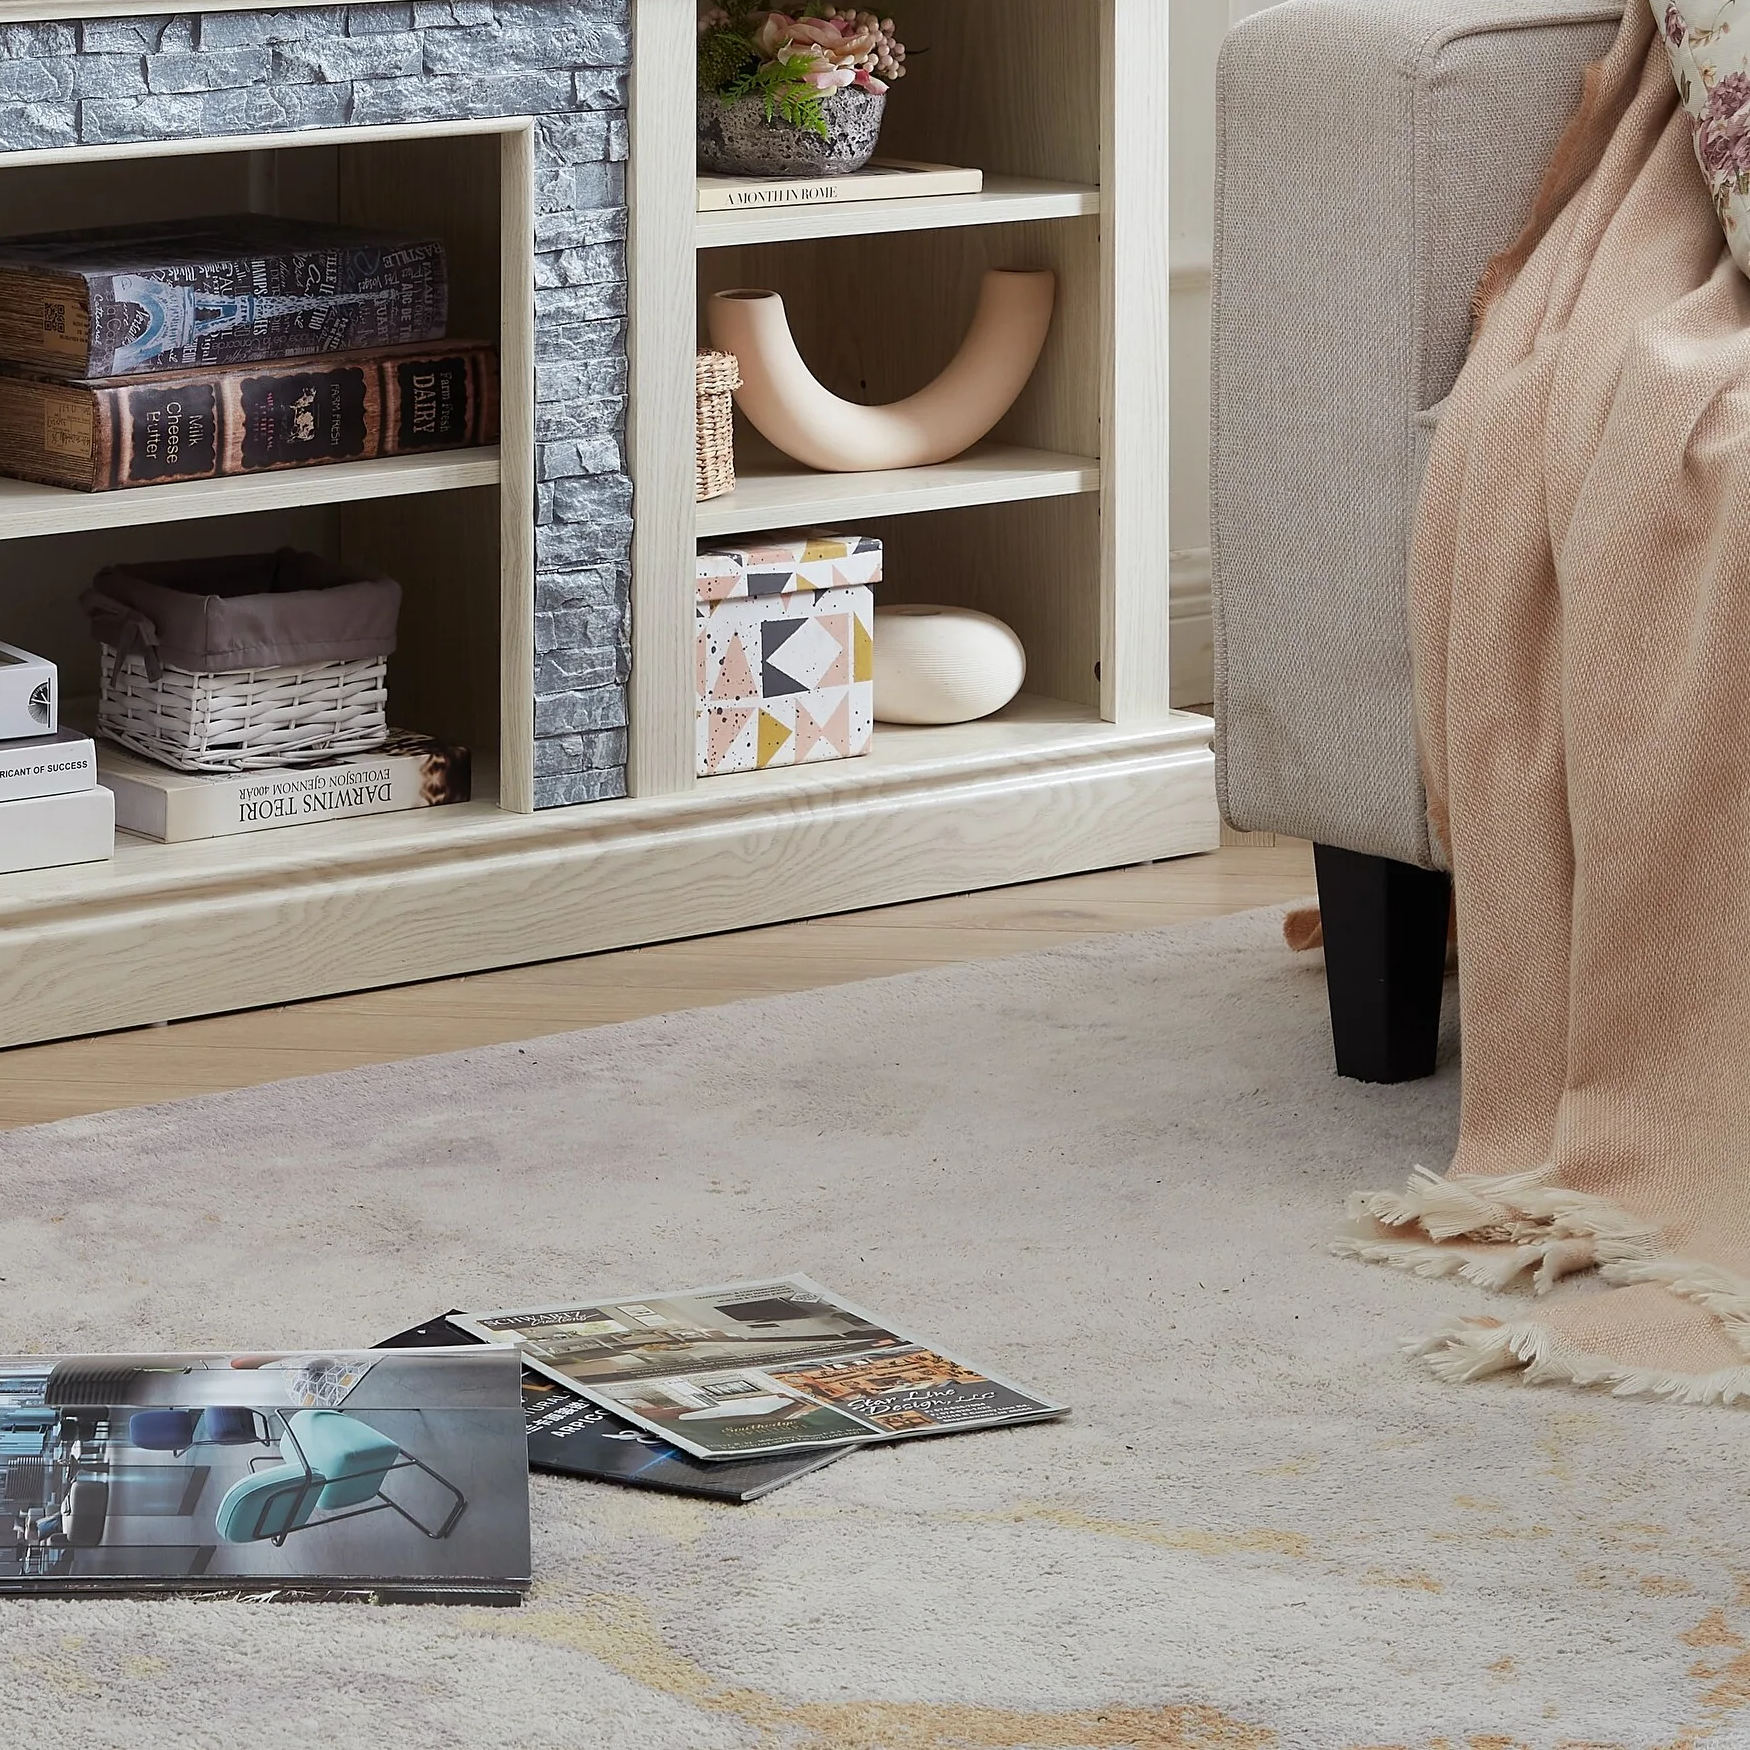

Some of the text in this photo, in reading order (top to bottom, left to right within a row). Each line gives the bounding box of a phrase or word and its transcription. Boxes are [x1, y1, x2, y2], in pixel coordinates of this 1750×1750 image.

[725, 186, 838, 205] A MONTH IN ROME
[412, 374, 436, 435] DAIRY
[440, 372, 454, 433] Farm Fresh
[146, 411, 161, 460] Butter
[166, 401, 182, 464] Cheese
[188, 414, 204, 446] Milk
[33, 765, 45, 776] OF
[47, 760, 88, 774] SUCCESS
[329, 768, 391, 788] EVOLUSJON
[273, 775, 326, 795] GJENNOM
[239, 783, 392, 823] DARWINS TEORI
[848, 1389, 956, 1412] Star Line
